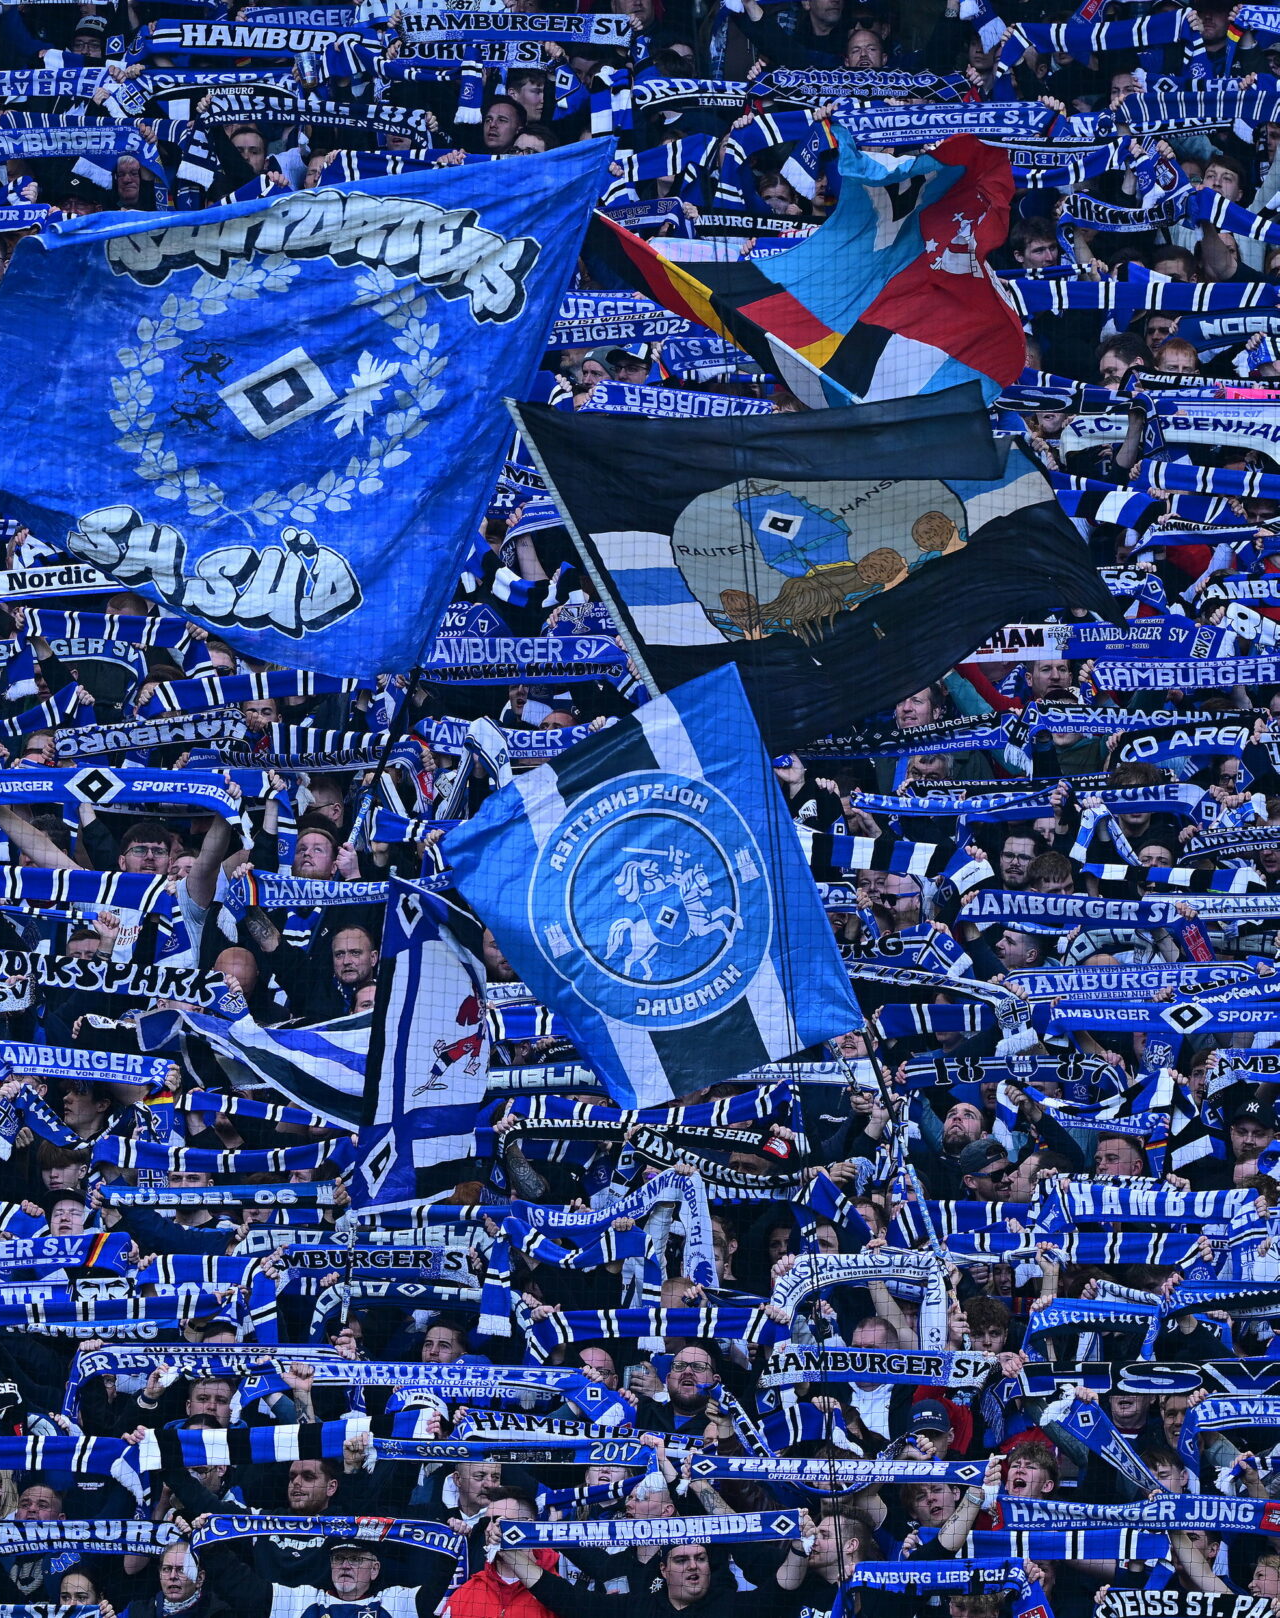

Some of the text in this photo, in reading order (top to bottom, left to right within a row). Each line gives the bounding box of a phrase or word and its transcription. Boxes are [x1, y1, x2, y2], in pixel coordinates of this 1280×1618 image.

[406, 16, 632, 36] HAMBURGER SV
[207, 86, 254, 96] HAMBURG
[840, 110, 1046, 132] HAMBURGER S.V.
[645, 320, 690, 337] 2025
[1072, 415, 1121, 438] F.C.
[7, 568, 96, 592] Nordic
[1080, 628, 1188, 643] HAMBURGER SV
[575, 639, 607, 661] SV
[1194, 640, 1210, 659] HSV
[1100, 666, 1276, 687] HAMBURGER
[903, 713, 997, 735] HAMBURGER SV
[1046, 725, 1108, 734] HAMBURGER
[909, 740, 997, 755] HAMBURGER SV
[916, 779, 1017, 788] HAMBURGER SV
[963, 893, 1139, 921] HAMBURGER
[934, 1054, 1111, 1086] 18 87
[713, 1126, 763, 1145] SEHR
[109, 1189, 297, 1207] NÜBBEL 06
[42, 1238, 84, 1258] S.V.
[766, 1351, 990, 1383] HAMBURGER SV
[354, 1378, 379, 1386] MEIN
[416, 1442, 470, 1460] since
[590, 1440, 643, 1462] 2017
[727, 1459, 948, 1476] TEAM NORDHEIDE
[768, 1473, 895, 1482] OFFIZIELLER SEIT 2018
[1011, 1499, 1256, 1524] HAMBURGER JUNG
[534, 1513, 763, 1543] TEAM NORDHEIDE
[1052, 1521, 1070, 1529] AUF
[1072, 1521, 1092, 1529] DEN
[53, 1541, 78, 1550] HAT
[83, 1541, 123, 1551] EINEN
[579, 1535, 711, 1547] OFFIZIELLER FANCLUB SEIT 2018
[852, 1567, 1005, 1586] HAMBURG LIEB' ICH
[1188, 1591, 1227, 1617] ST.
